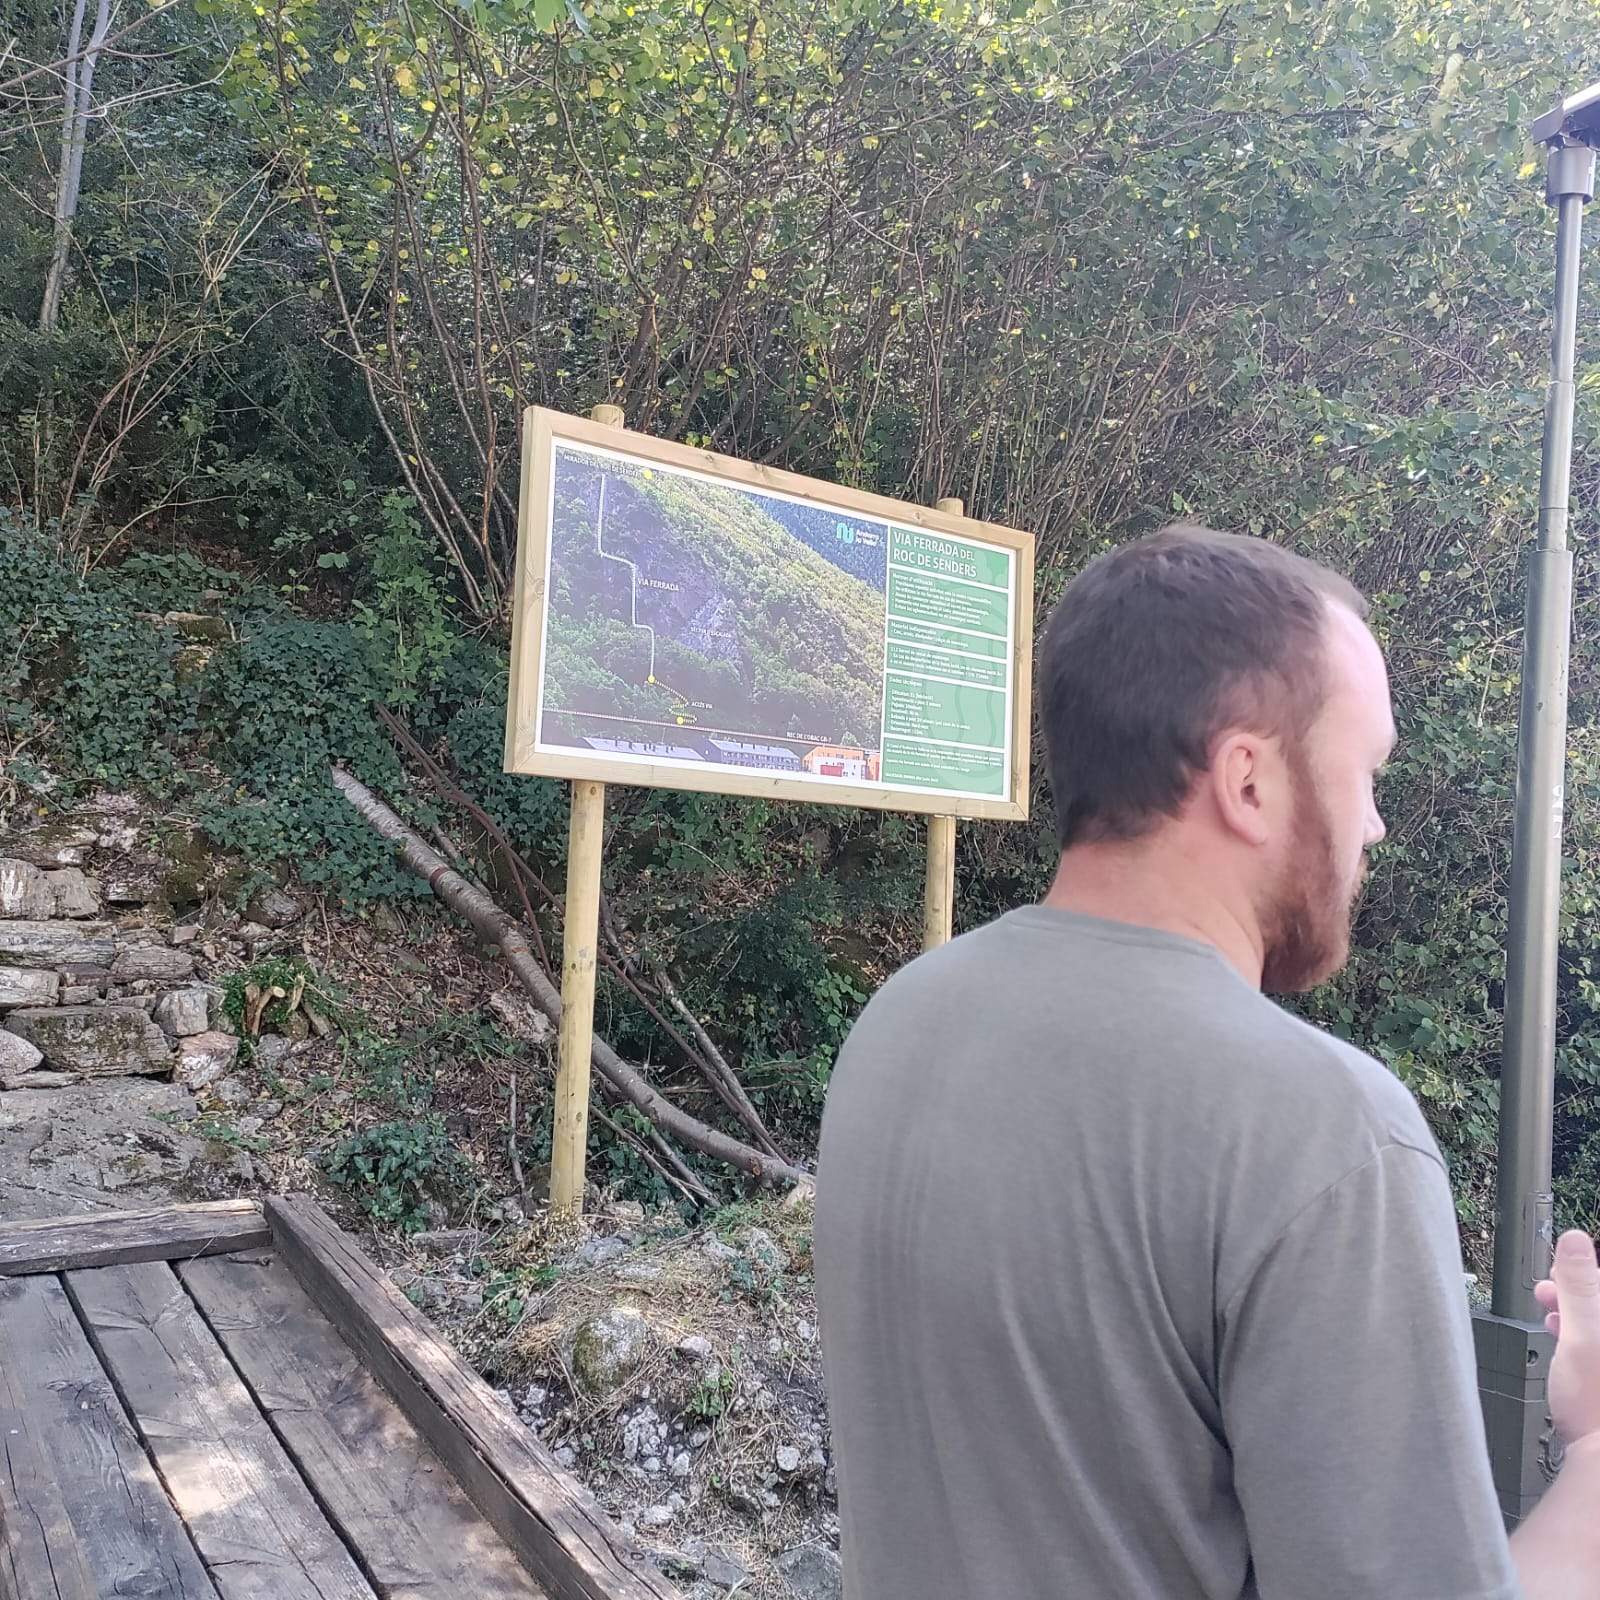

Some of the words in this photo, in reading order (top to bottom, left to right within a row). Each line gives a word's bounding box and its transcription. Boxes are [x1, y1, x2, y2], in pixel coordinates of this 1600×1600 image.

[894, 531, 912, 546] VIA
[913, 535, 960, 558] FERRADA
[960, 549, 975, 561] DEL
[894, 548, 916, 564] ROC
[917, 552, 932, 568] DE
[932, 557, 976, 578] SENDERS
[638, 578, 649, 586] VIA
[650, 580, 680, 591] FERRADA
